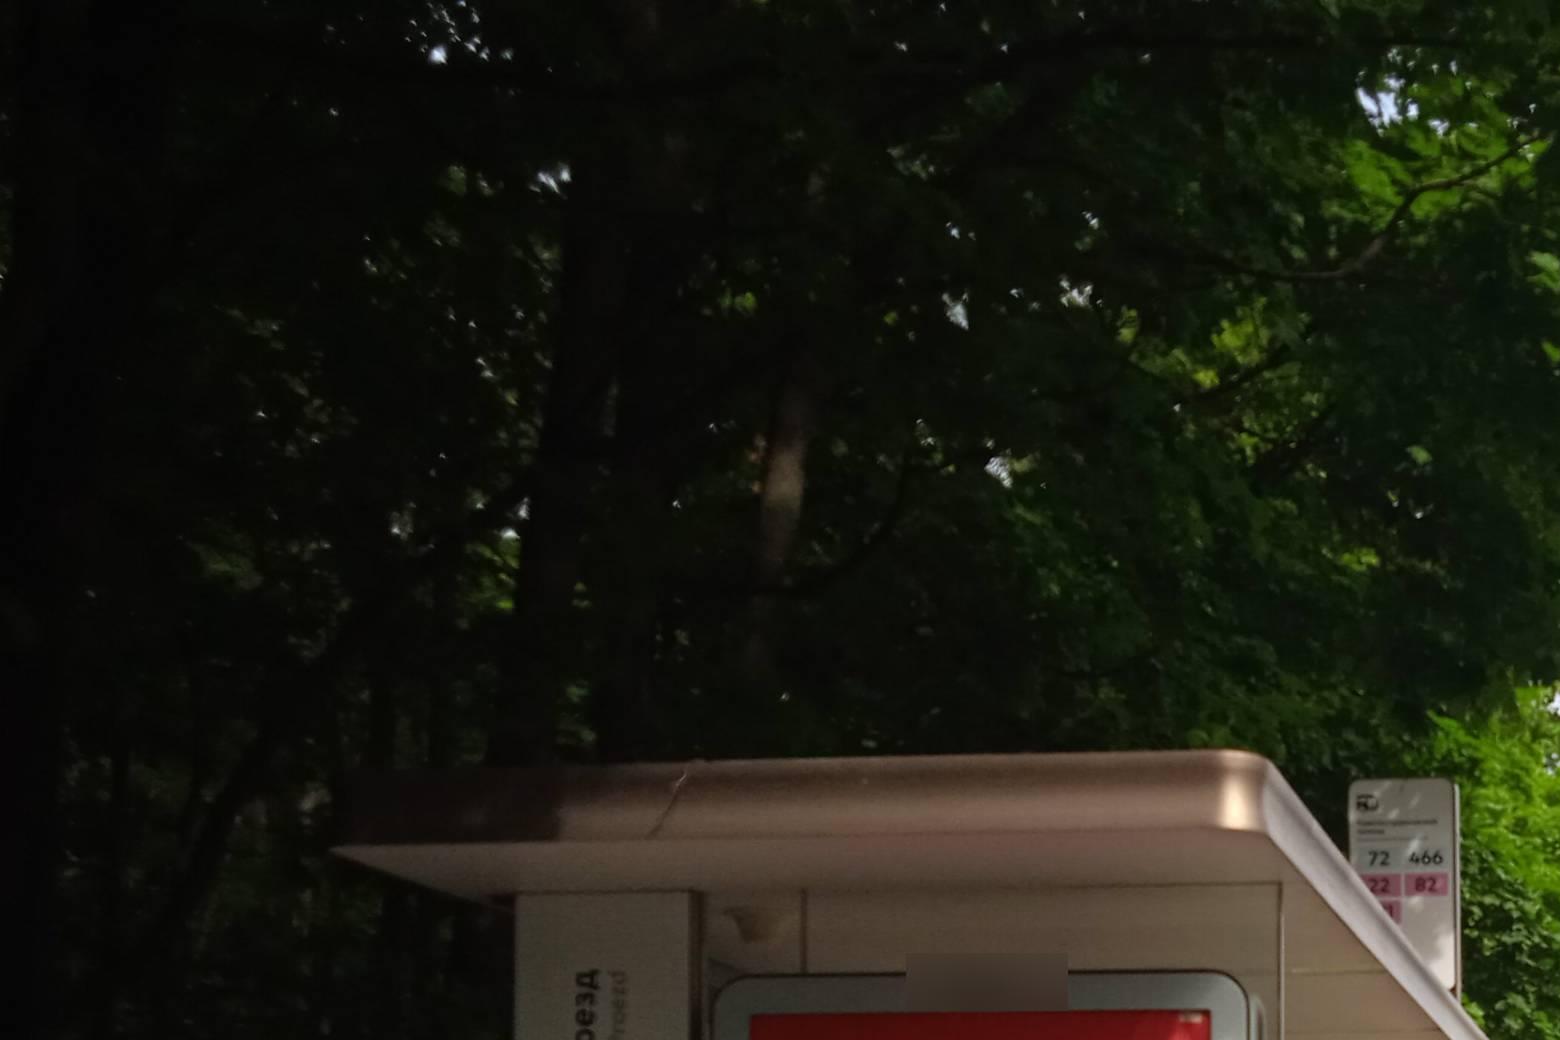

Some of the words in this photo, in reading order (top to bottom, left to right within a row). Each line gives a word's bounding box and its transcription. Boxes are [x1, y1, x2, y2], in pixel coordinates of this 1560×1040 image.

[1368, 850, 1391, 866] 72
[1408, 851, 1443, 866] 466
[1370, 879, 1391, 892] 22
